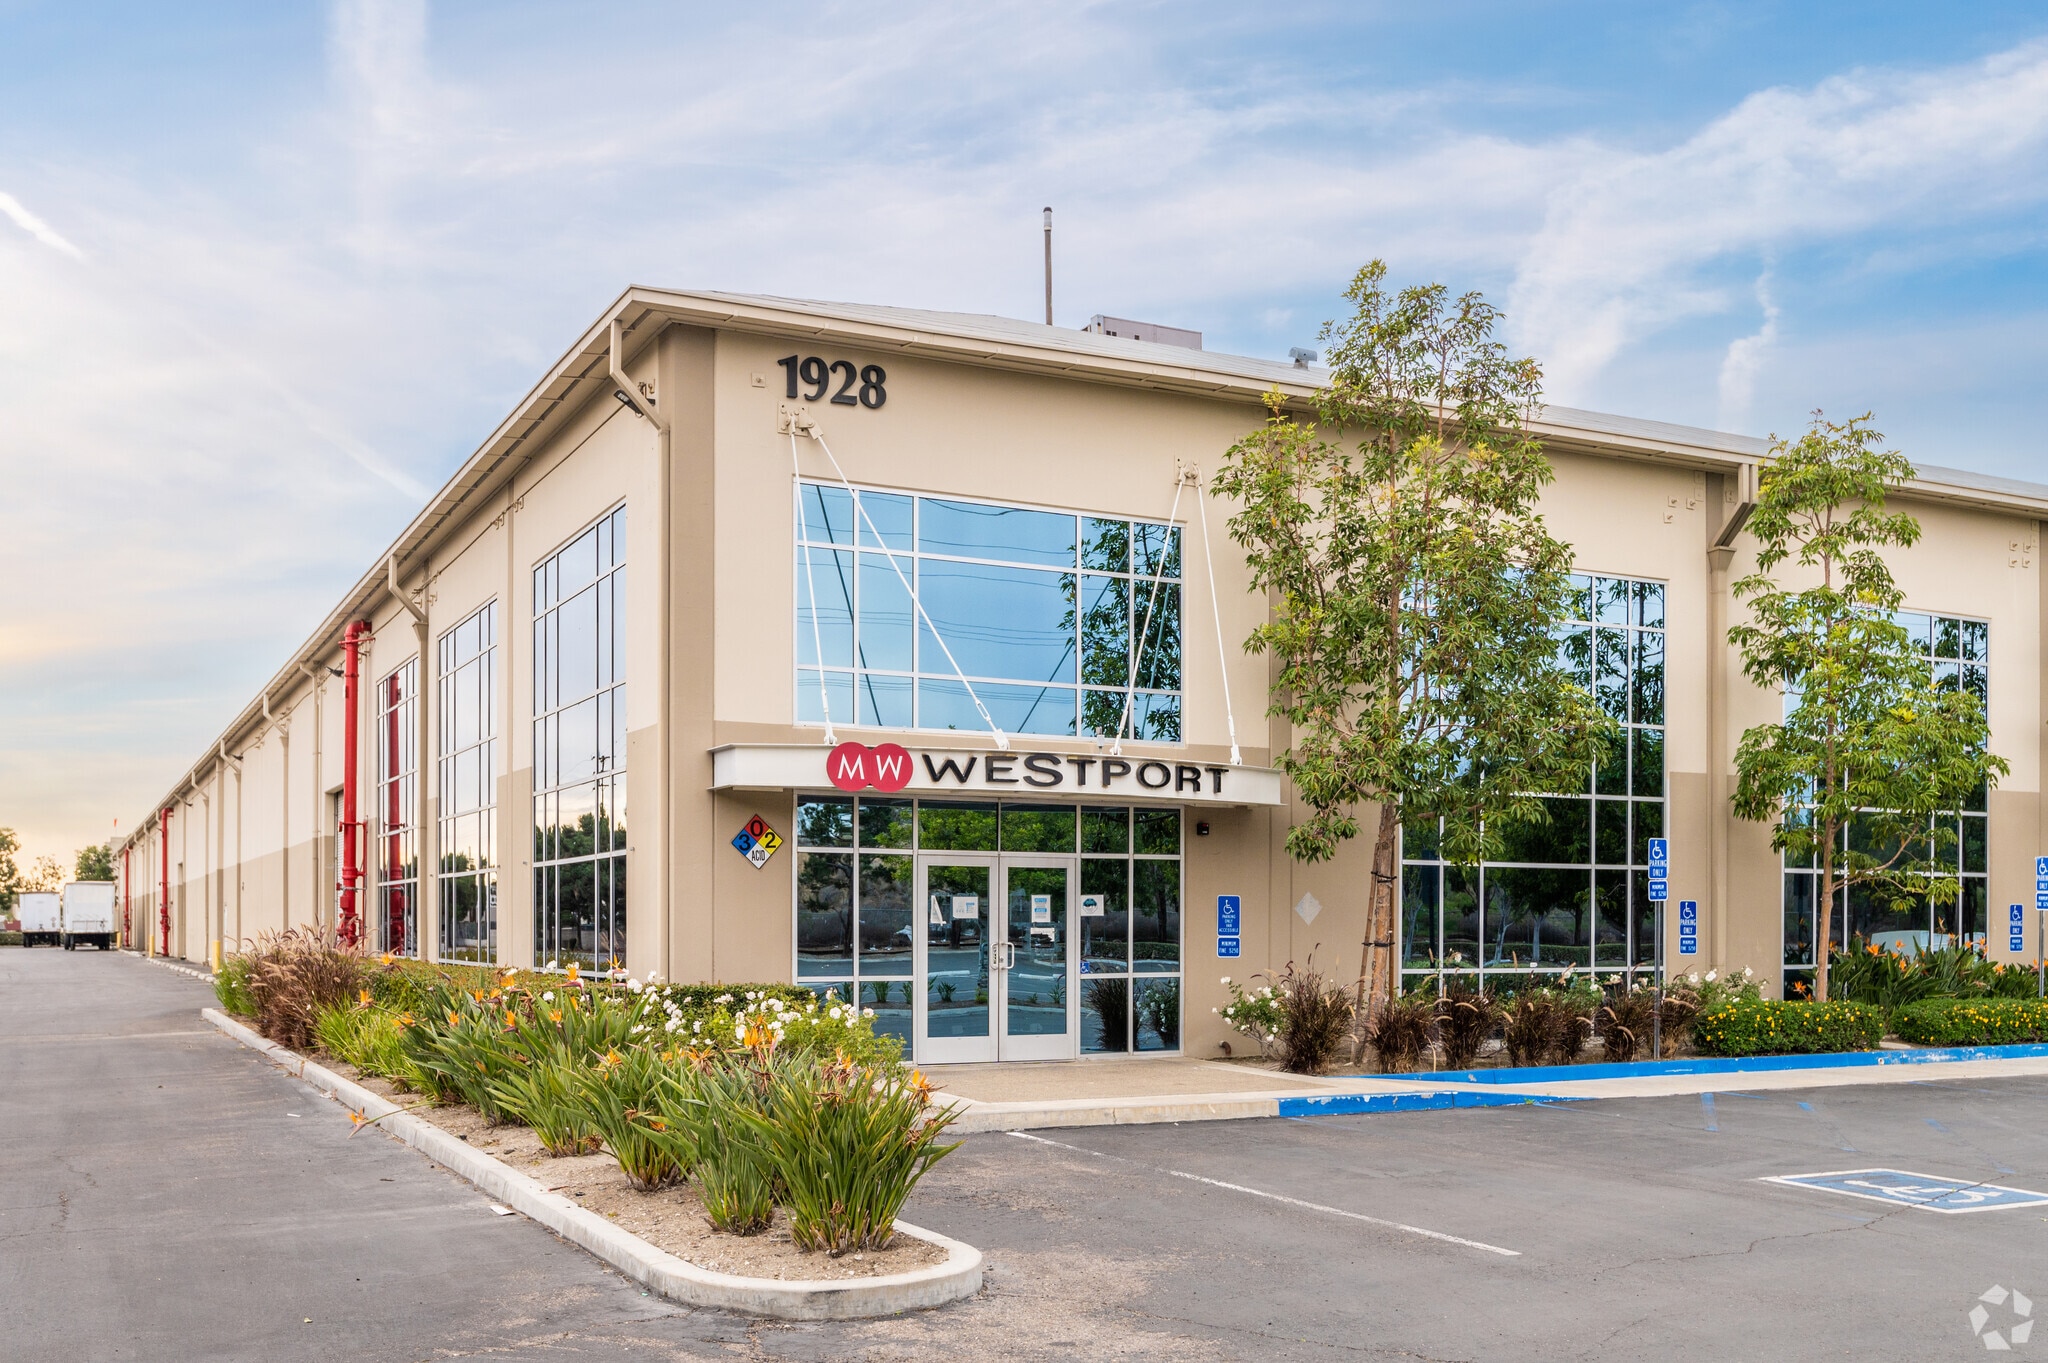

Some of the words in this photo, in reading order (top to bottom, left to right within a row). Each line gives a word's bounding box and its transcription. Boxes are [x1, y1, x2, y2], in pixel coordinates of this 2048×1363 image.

[777, 354, 887, 409] 1928
[922, 752, 1229, 794] WESTPORT
[750, 820, 764, 837] 0
[739, 833, 751, 851] 3
[764, 832, 776, 849] 2
[751, 849, 766, 861] ACID
